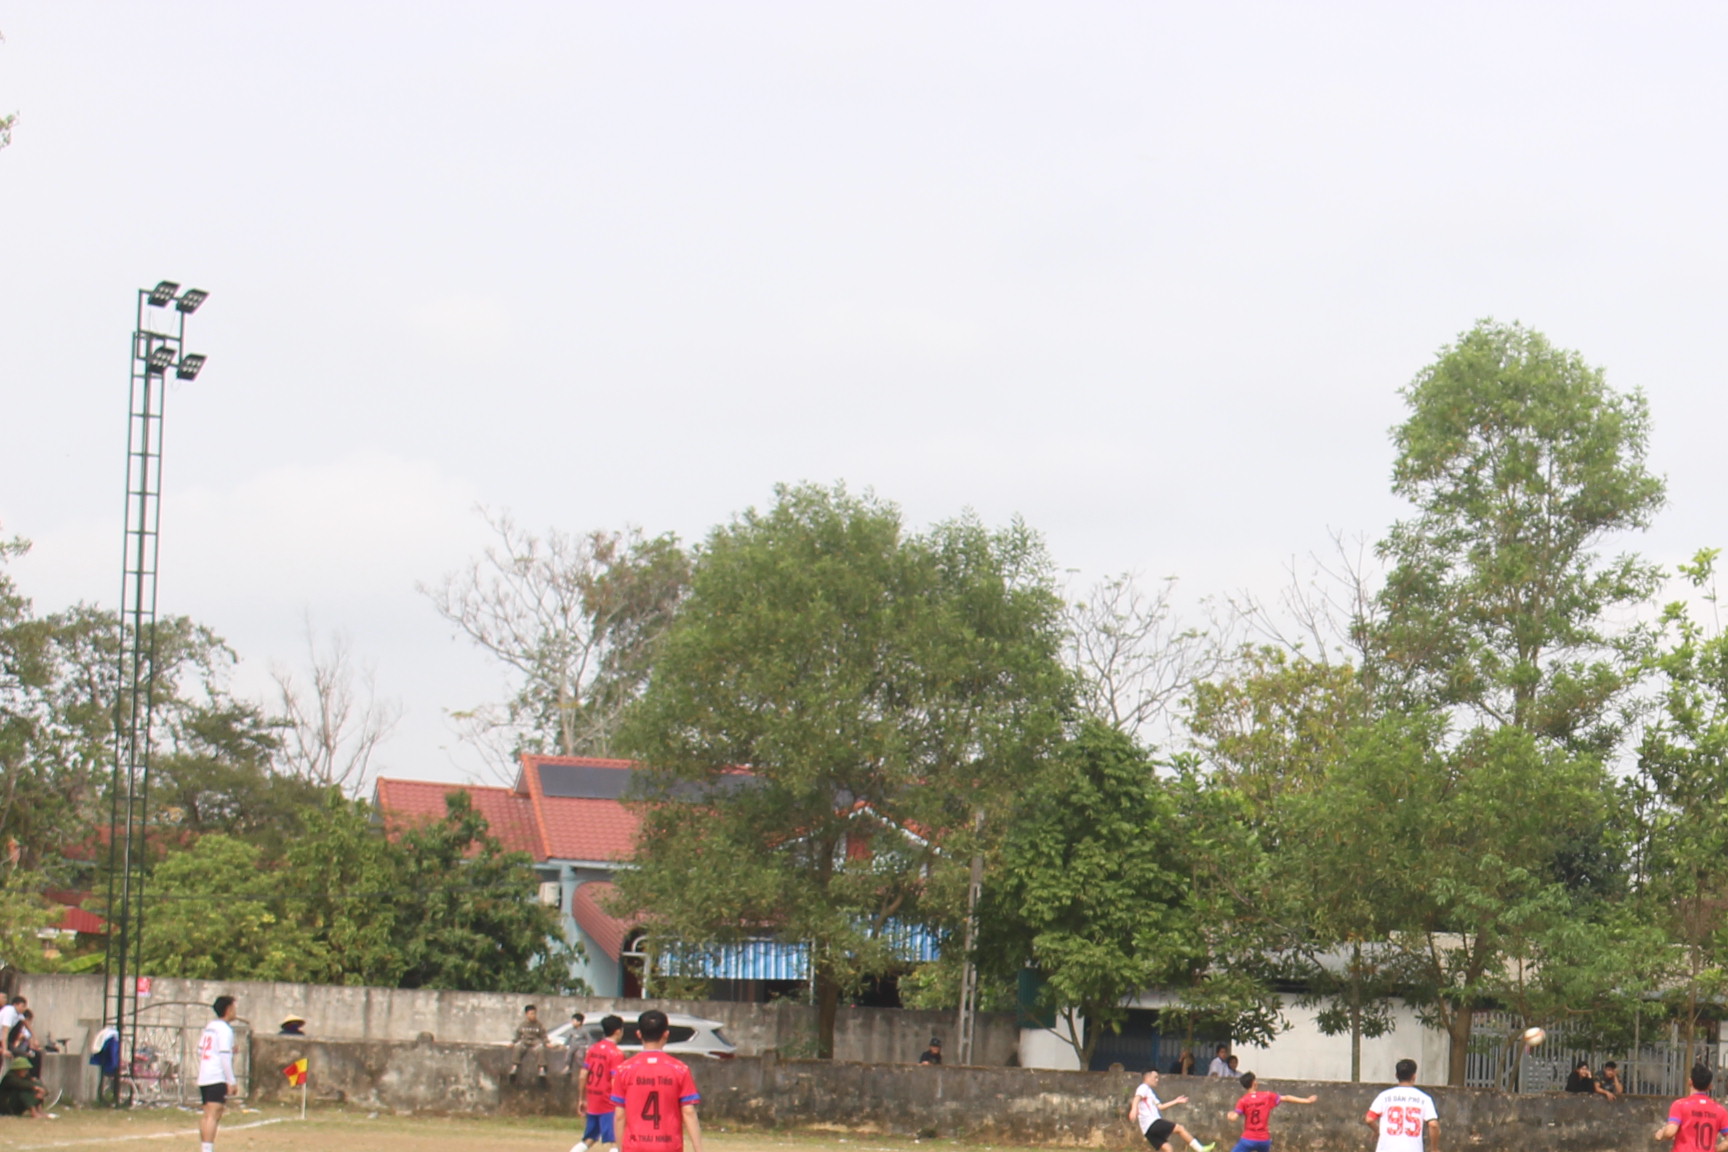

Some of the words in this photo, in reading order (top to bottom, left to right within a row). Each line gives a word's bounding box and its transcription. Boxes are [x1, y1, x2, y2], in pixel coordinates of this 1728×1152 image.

[587, 1061, 604, 1087] 69
[641, 1091, 661, 1130] 4
[1251, 1109, 1260, 1125] 8
[1387, 1106, 1422, 1137] 95
[1693, 1121, 1714, 1151] 10
